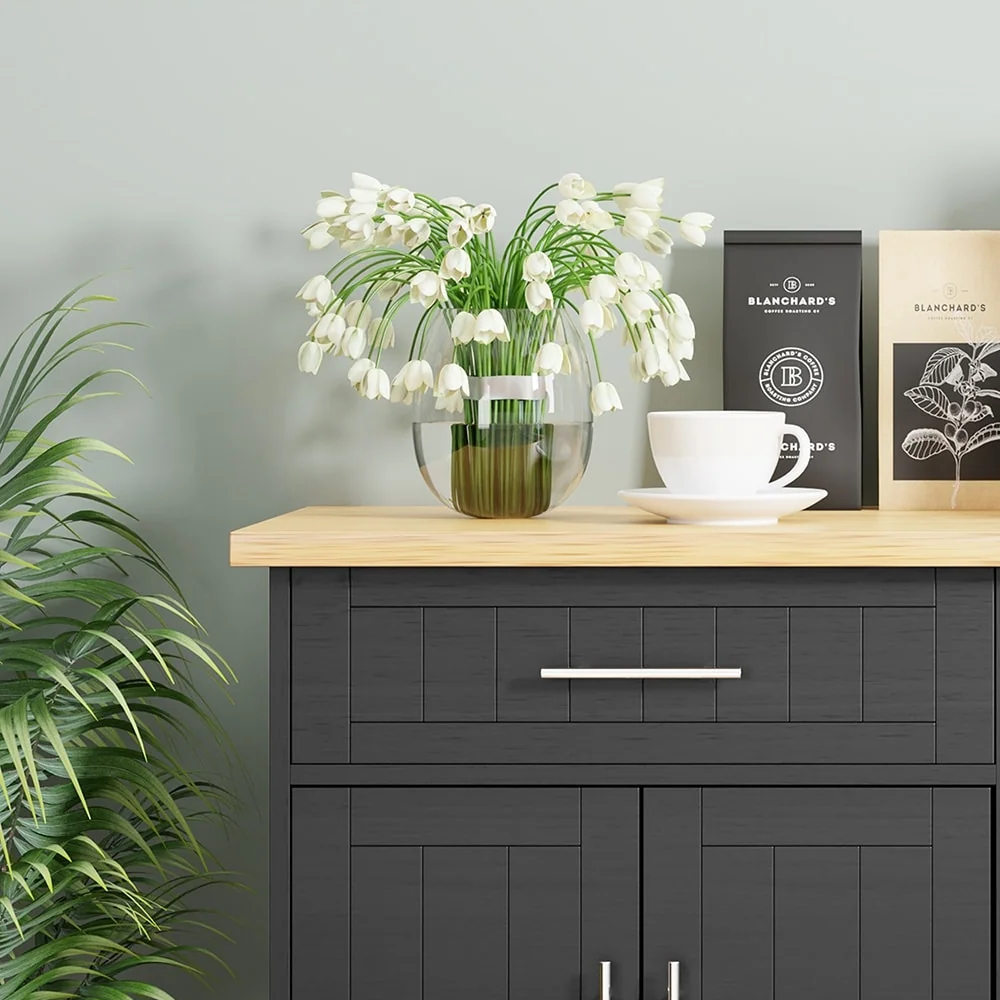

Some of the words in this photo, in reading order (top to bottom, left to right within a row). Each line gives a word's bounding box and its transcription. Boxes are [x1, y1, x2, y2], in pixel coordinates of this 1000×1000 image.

[748, 296, 836, 306] BLANCHARD'S
[914, 303, 986, 312] BLANCHARD'S
[763, 351, 802, 376] BLANCHARD'S
[803, 354, 820, 376] COFFEE
[765, 383, 791, 403] ROASTING
[792, 383, 818, 403] COMPANY
